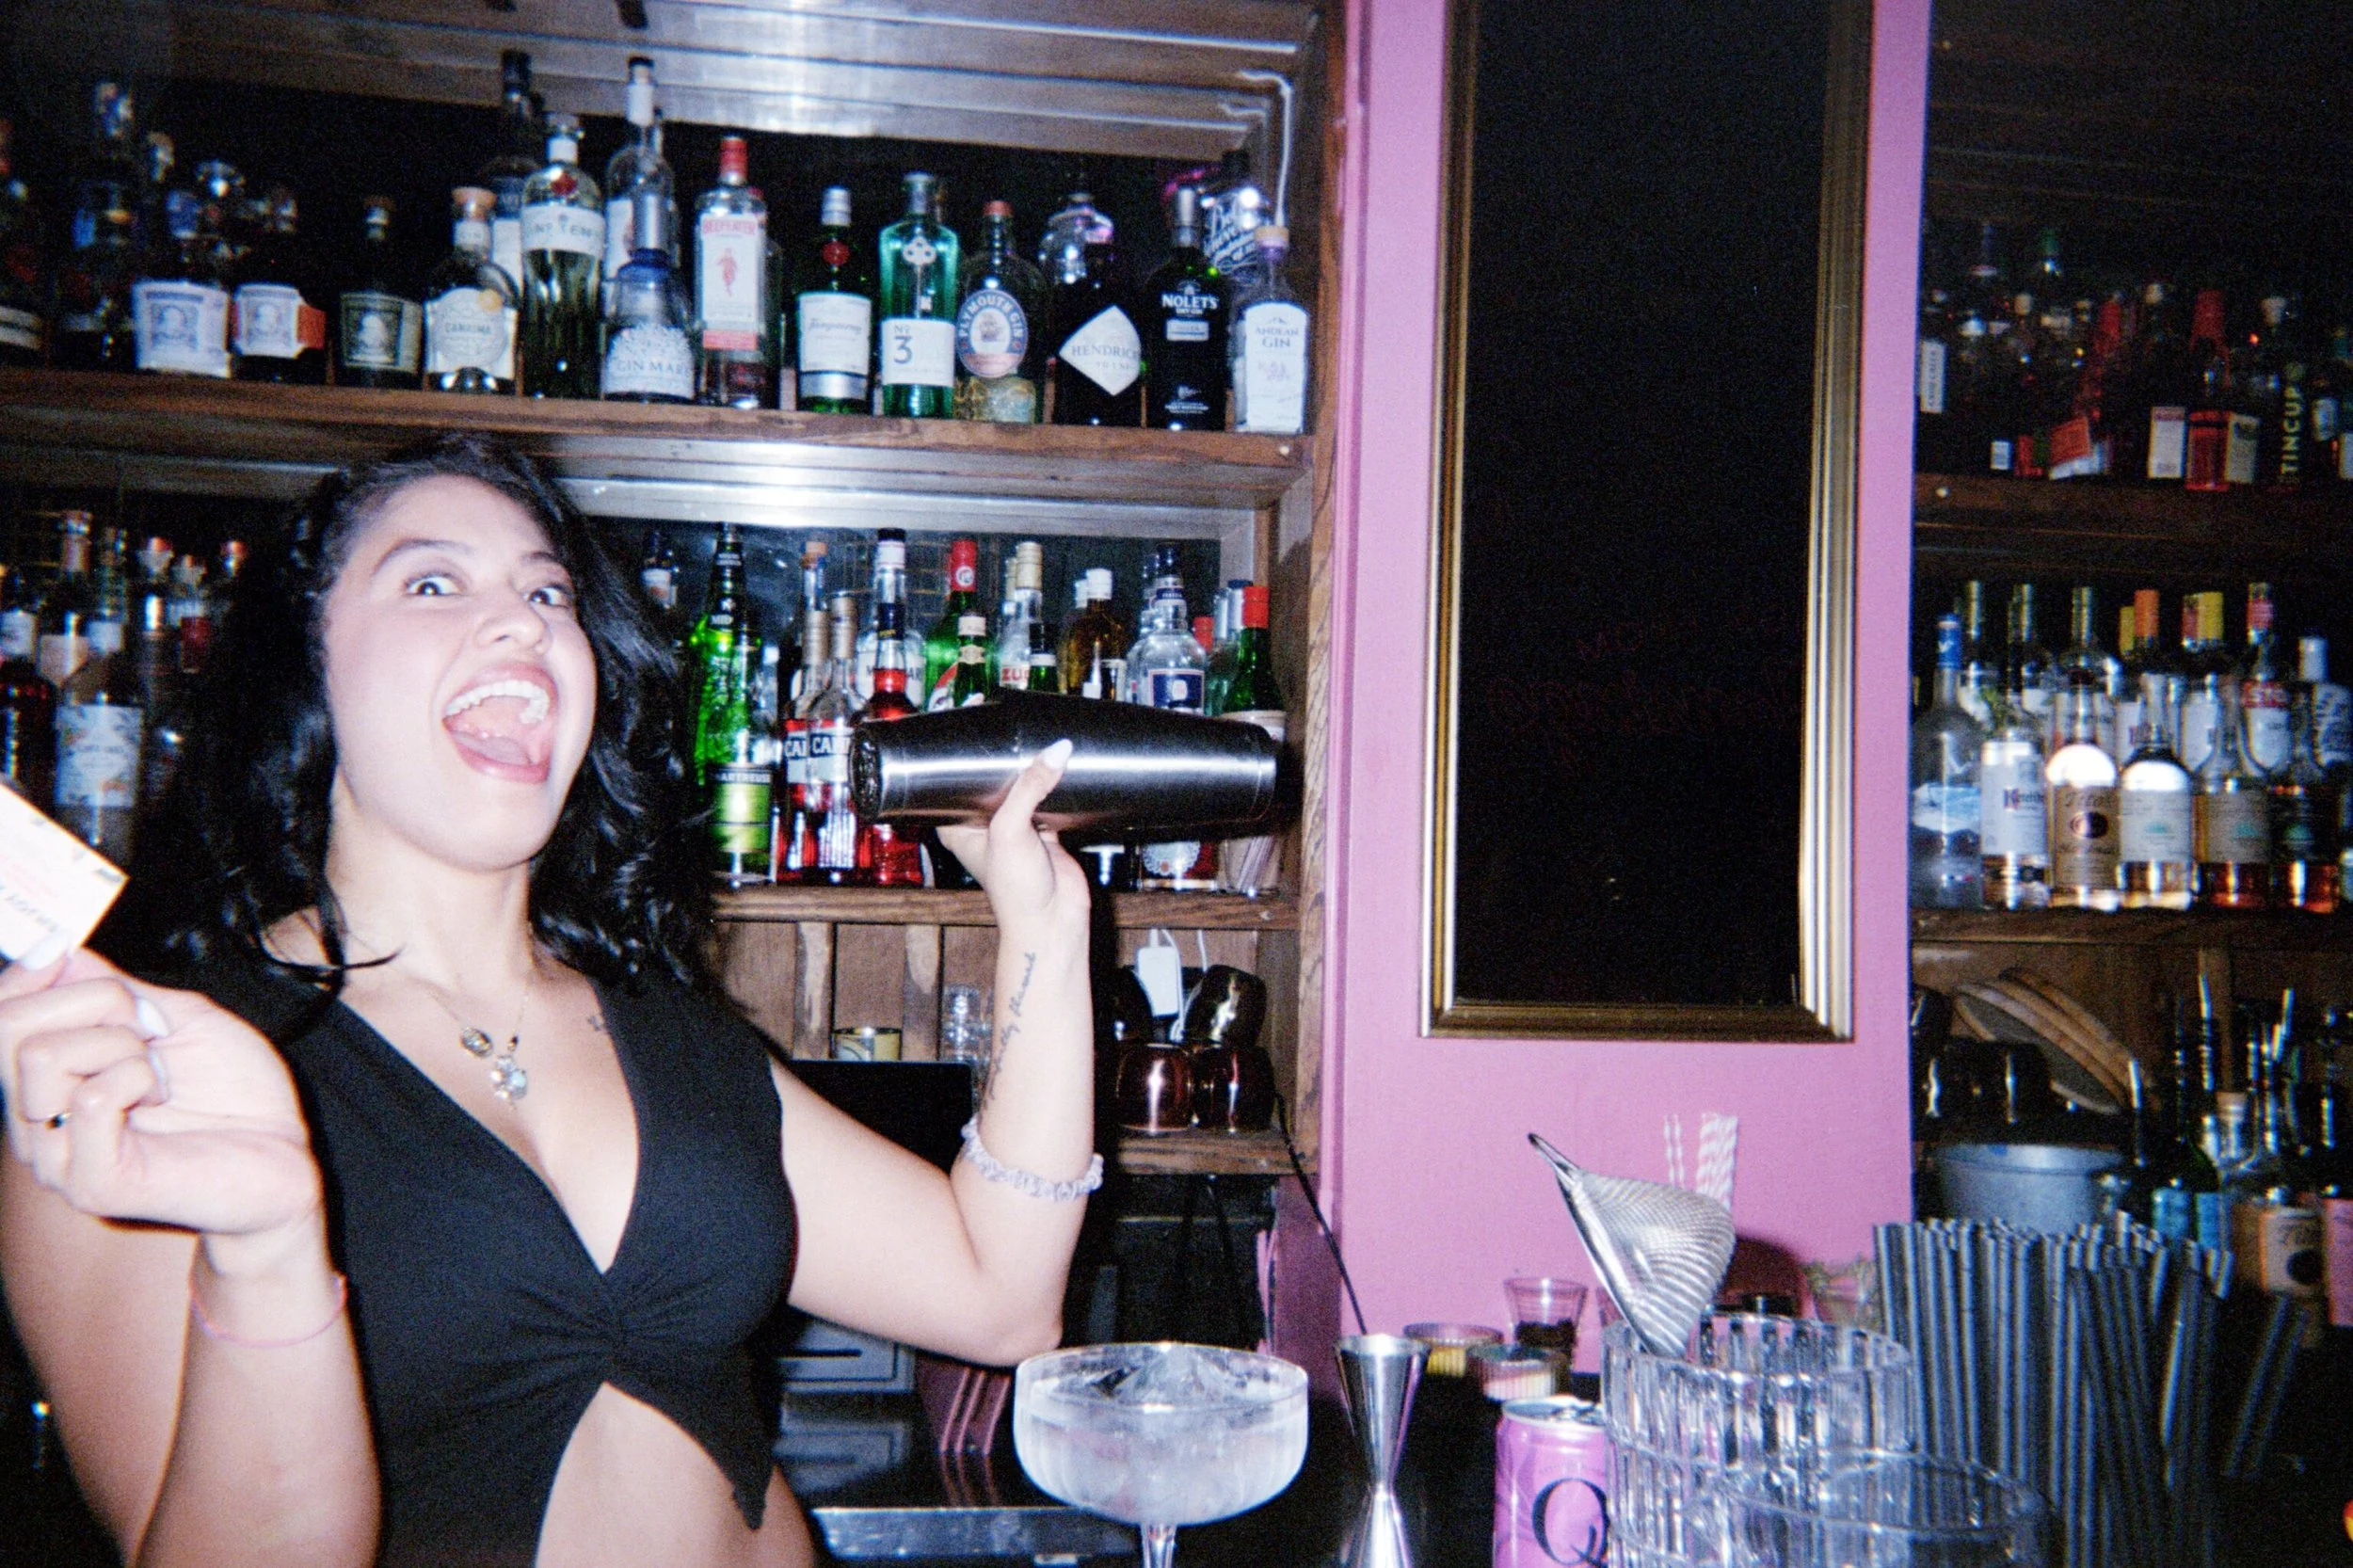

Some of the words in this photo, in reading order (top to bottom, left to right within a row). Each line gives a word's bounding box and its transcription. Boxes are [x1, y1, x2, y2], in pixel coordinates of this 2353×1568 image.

[958, 295, 1014, 338] PLYMOUTH
[1009, 312, 1024, 338] GIN
[1161, 293, 1218, 311] NOLET'S
[893, 335, 913, 365] 3
[1261, 337, 1290, 348] GIN
[616, 359, 644, 372] GIN
[2281, 385, 2301, 474] TINCUP
[1532, 1477, 1611, 1568] Q
